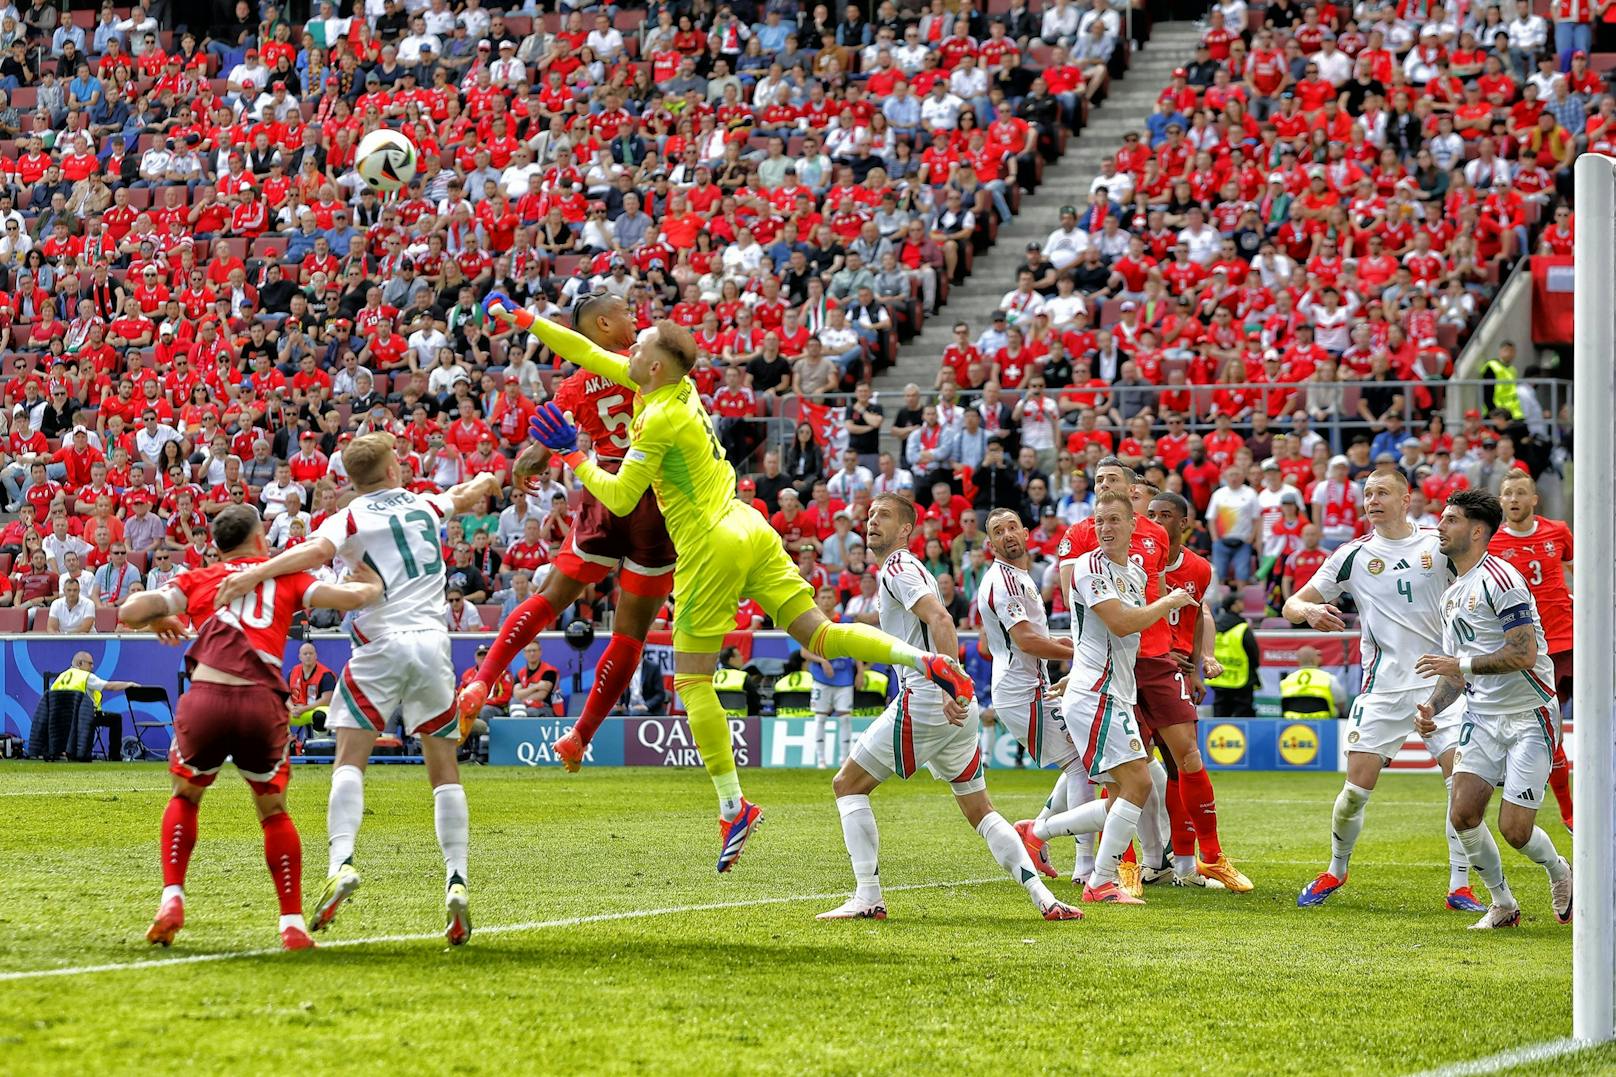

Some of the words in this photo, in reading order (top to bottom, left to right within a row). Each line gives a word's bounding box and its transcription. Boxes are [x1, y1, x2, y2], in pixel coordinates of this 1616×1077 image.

[366, 315, 378, 327] 10
[596, 393, 632, 449] 5
[388, 509, 443, 579] 13
[1528, 559, 1543, 586] 3
[1396, 578, 1412, 602] 4
[1452, 617, 1475, 645] 10
[1118, 711, 1135, 735] 2
[1353, 703, 1364, 727] 4
[637, 719, 748, 753] QAR
[517, 741, 594, 766] QAR
[663, 748, 749, 766] AIRS
